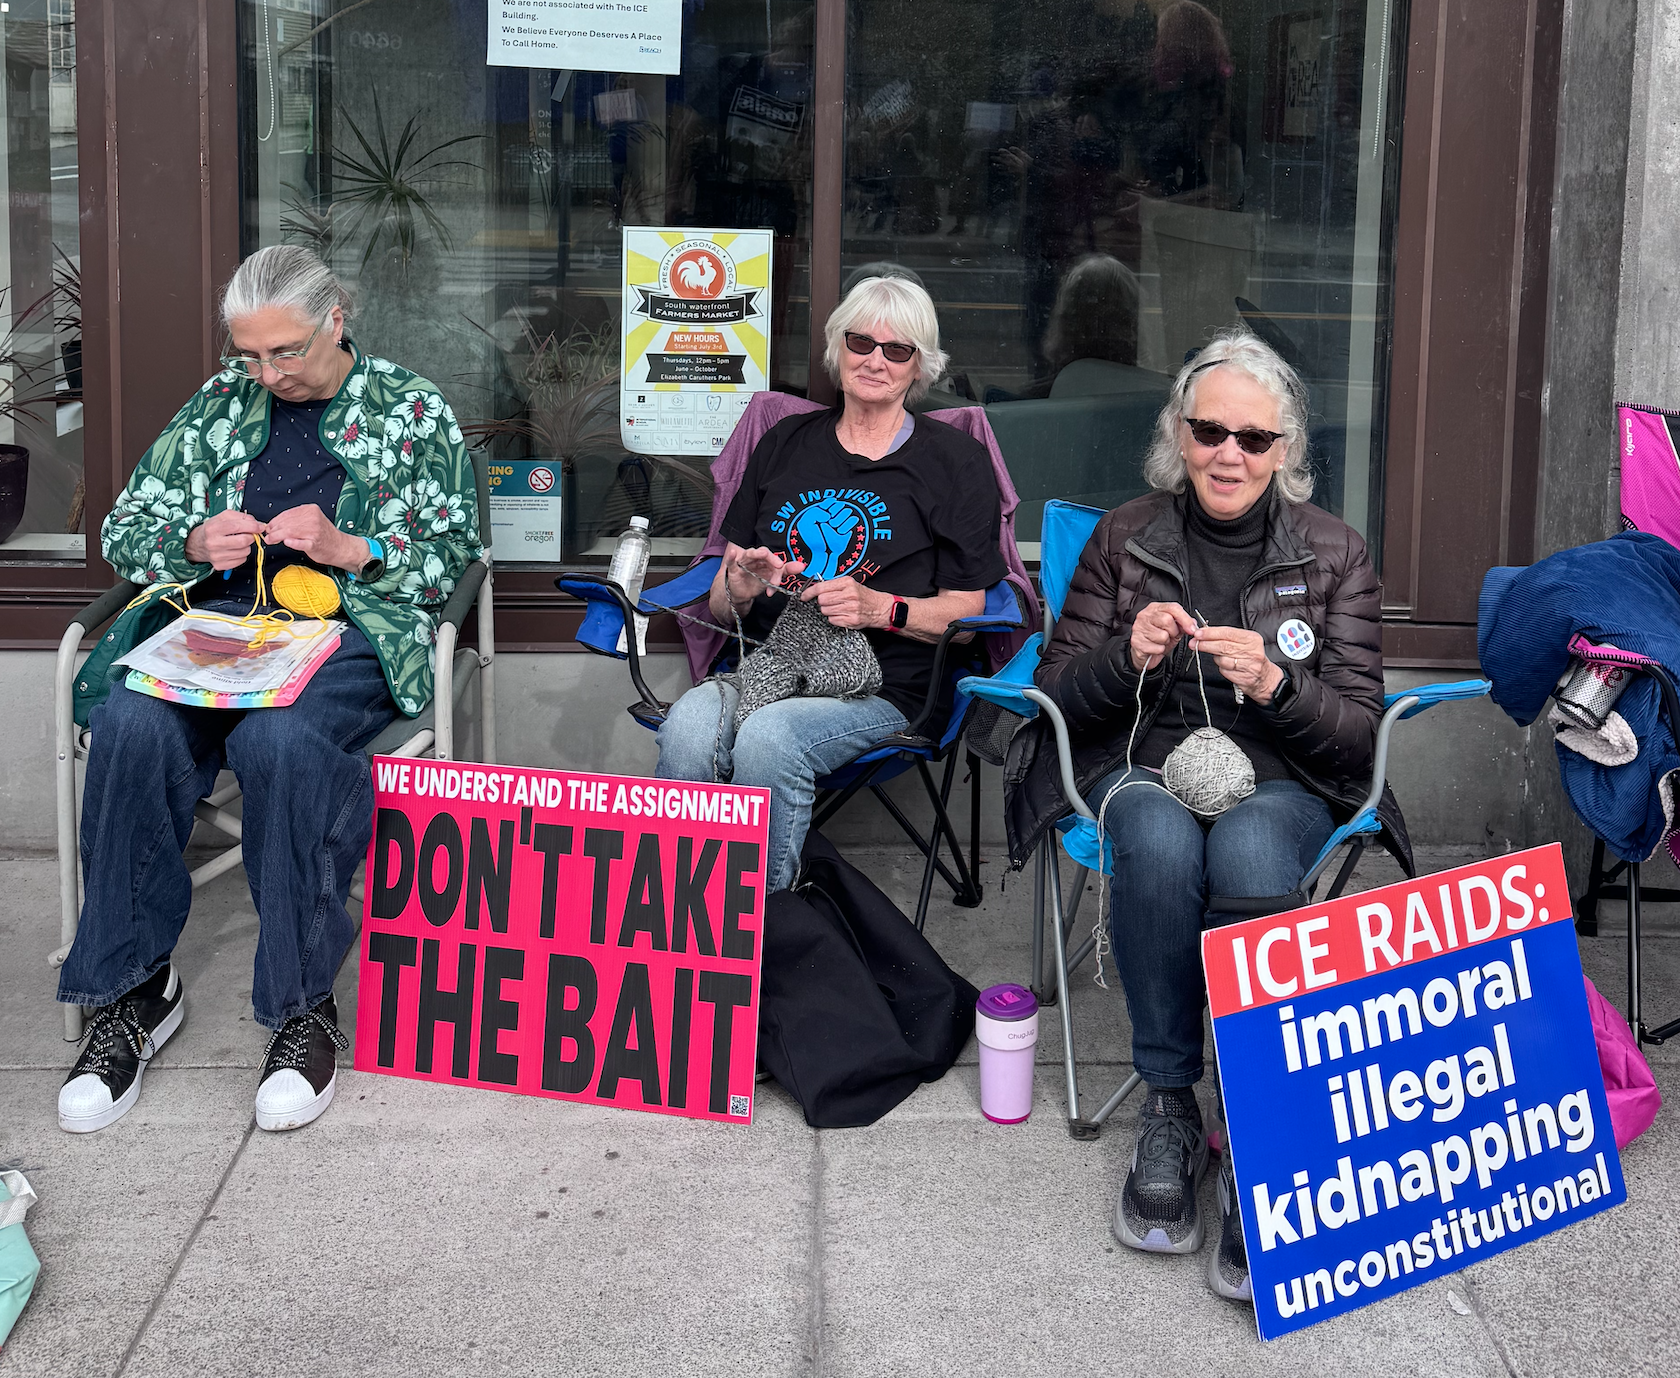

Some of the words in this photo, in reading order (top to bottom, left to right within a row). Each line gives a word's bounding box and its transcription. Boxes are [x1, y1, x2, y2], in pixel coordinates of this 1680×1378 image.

[502, 11, 539, 21] Building.
[548, 1, 594, 9] associated
[596, 3, 615, 11] with
[616, 3, 632, 12] The
[633, 4, 648, 13] ICE
[501, 26, 516, 34] We
[517, 26, 548, 35] Believe
[549, 28, 588, 38] Everyone
[589, 30, 629, 39] Deserves
[630, 32, 637, 40] A
[638, 32, 662, 41] Place
[501, 39, 511, 47] To
[512, 39, 530, 47] Call
[531, 40, 558, 49] Home.
[675, 241, 721, 256] SEASONAL
[662, 258, 671, 289] FRESH
[725, 261, 734, 290] LOCAL
[655, 308, 700, 319] FARMERS
[701, 310, 740, 319] MARKET
[664, 302, 687, 310] south
[688, 302, 730, 311] waterfront
[673, 333, 692, 343] NEW
[693, 334, 720, 343] HOURS
[770, 501, 796, 534] SW
[798, 488, 893, 541] INDIVISIBLE
[524, 535, 554, 544] oregon
[377, 762, 411, 794] WE
[413, 766, 563, 809] UNDERSTAND
[566, 779, 609, 813] THE
[612, 784, 765, 827] ASSIGNMENT
[369, 806, 574, 939] DON'T
[583, 826, 761, 961] TAKE
[1231, 915, 1338, 1008] ICE
[1356, 864, 1550, 974] RAIDS:
[1278, 938, 1533, 1074] immoral
[368, 931, 526, 1087] THE
[540, 952, 753, 1115] BAIT
[1327, 1022, 1517, 1144] illegal
[1252, 1088, 1596, 1253] kidnapping
[1274, 1152, 1612, 1320] unconstitutional
